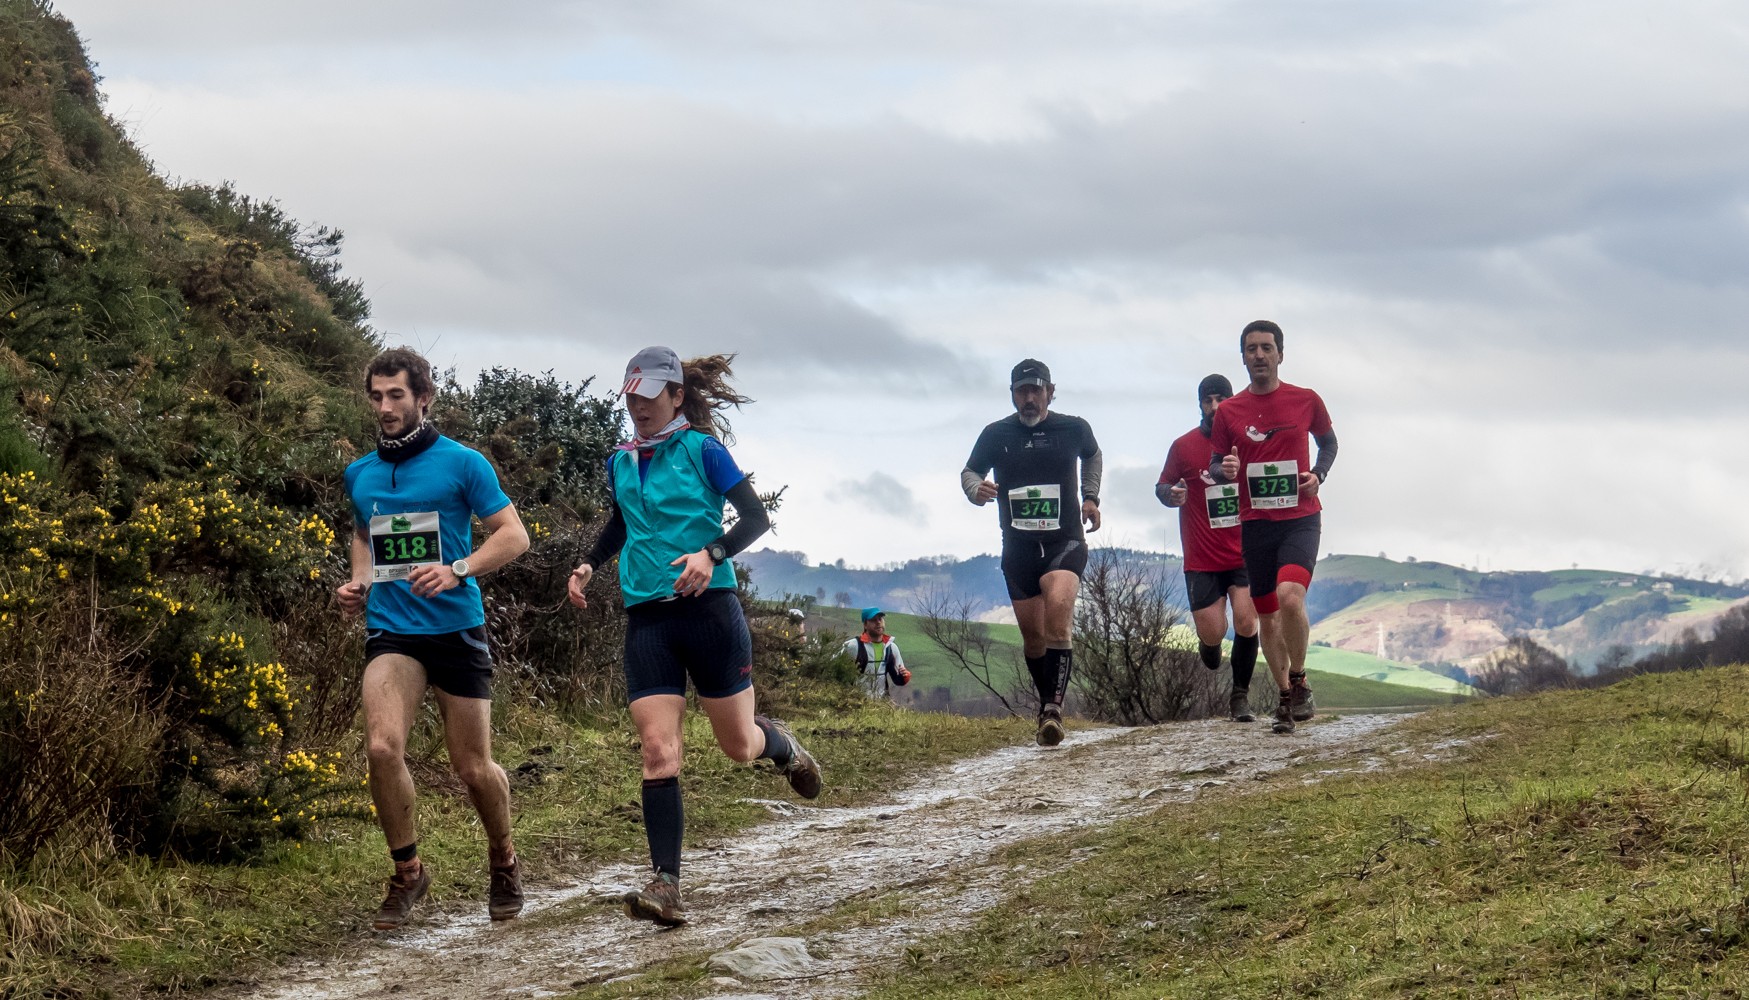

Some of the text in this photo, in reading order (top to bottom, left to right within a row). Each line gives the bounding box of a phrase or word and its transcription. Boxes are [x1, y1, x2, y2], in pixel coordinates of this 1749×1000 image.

[1258, 478, 1289, 494] 373
[1021, 501, 1051, 516] 374
[1217, 499, 1239, 514] 35
[384, 536, 427, 561] 318
